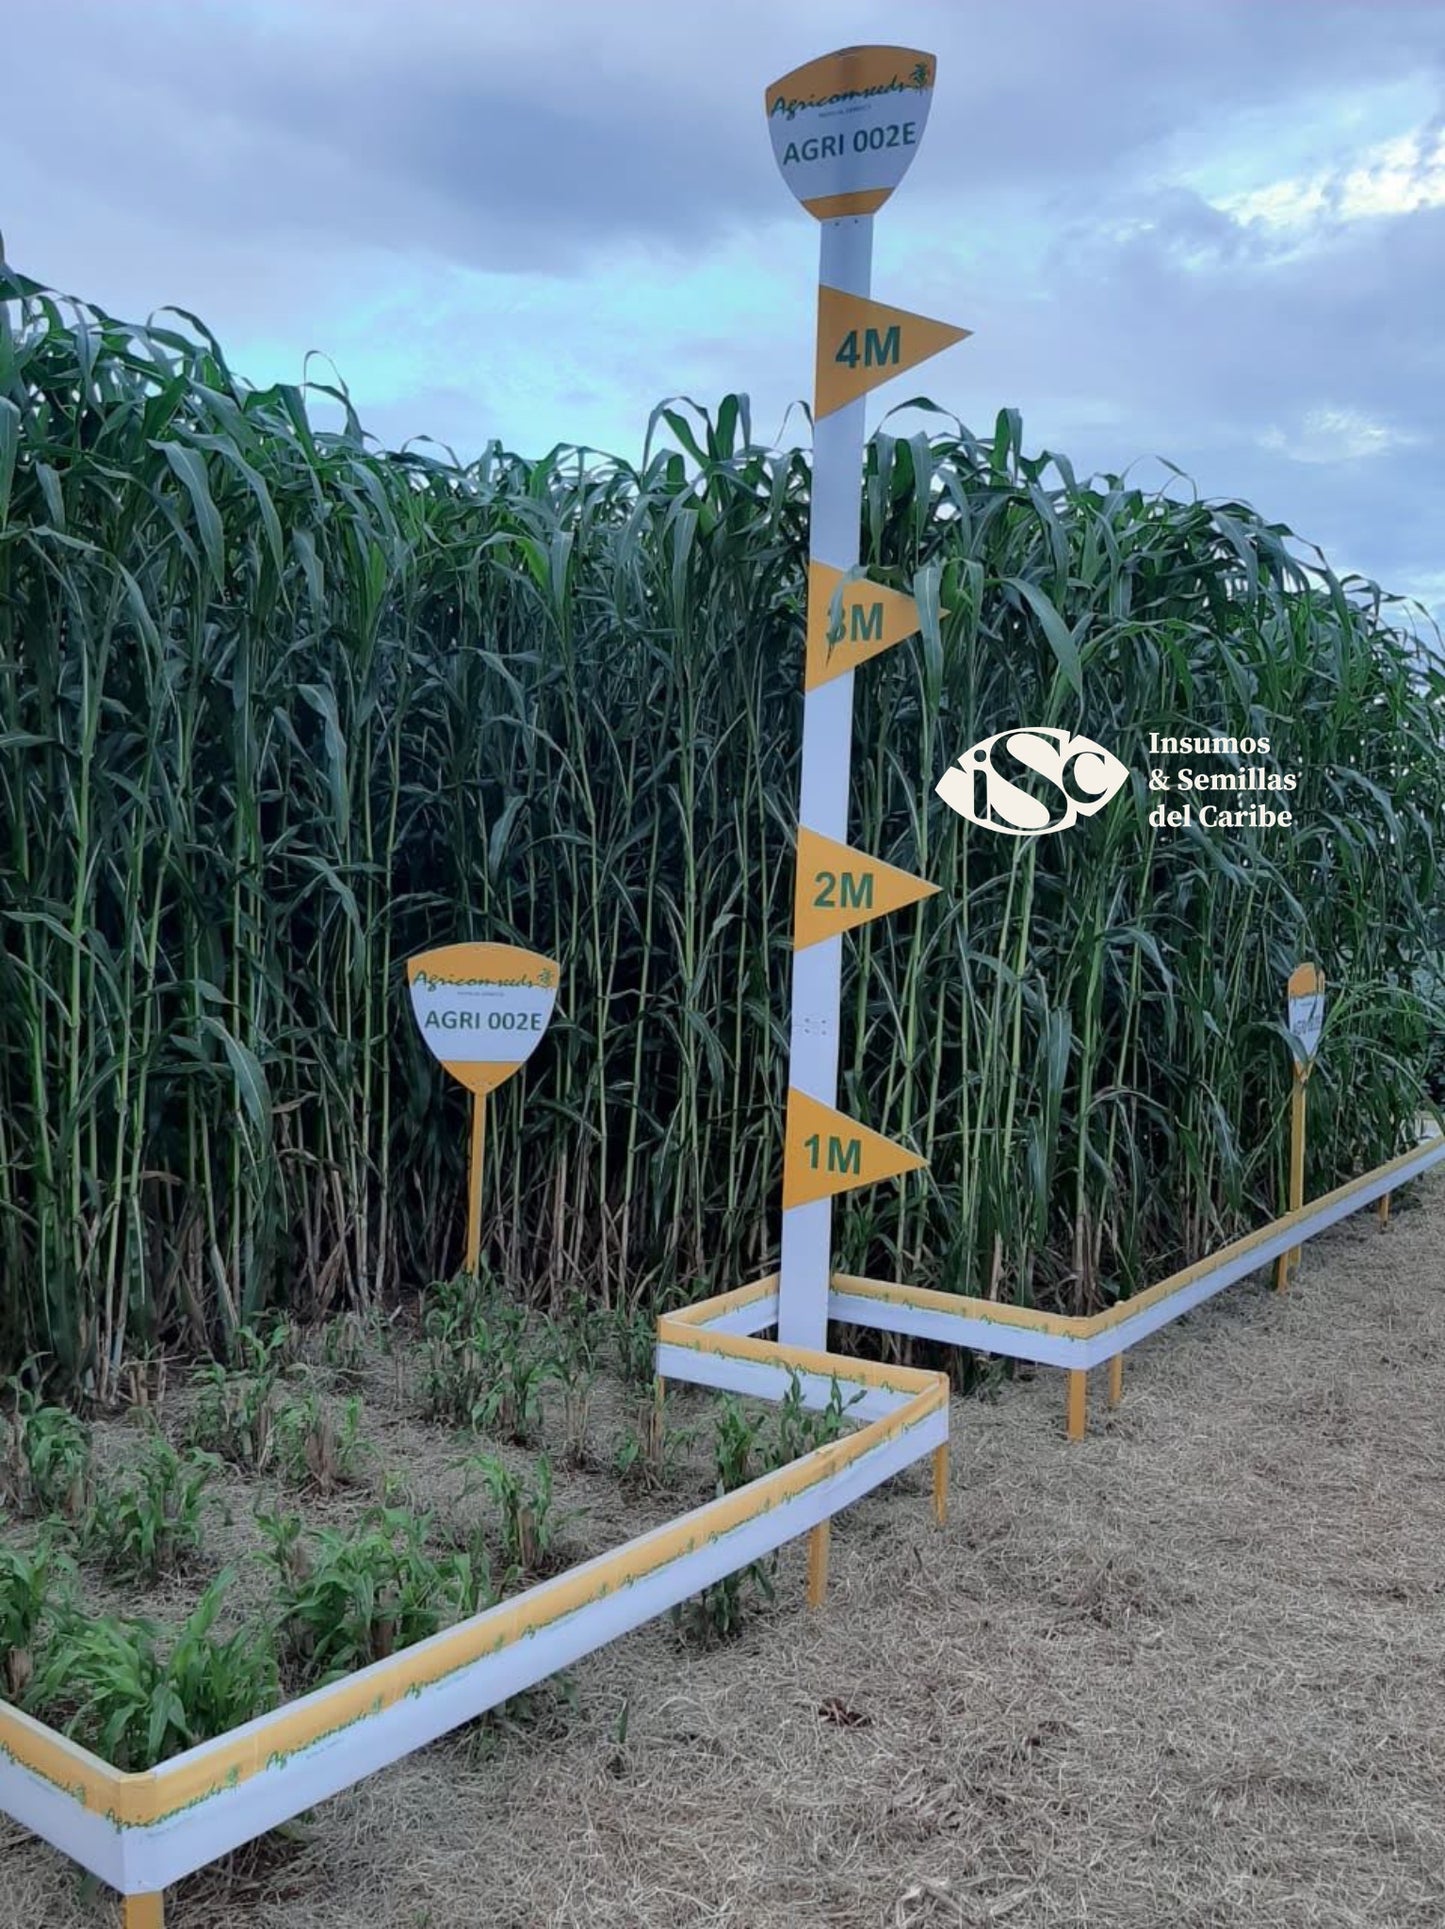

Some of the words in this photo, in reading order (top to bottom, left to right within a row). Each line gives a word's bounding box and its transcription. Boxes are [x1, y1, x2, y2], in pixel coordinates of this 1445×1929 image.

[783, 133, 844, 166] AGRI
[853, 121, 916, 153] 002E
[835, 325, 901, 369] 4M
[813, 871, 874, 909] 2M
[424, 1010, 480, 1029] AGRI
[488, 1011, 542, 1031] 002E
[804, 1133, 862, 1175] 1M
